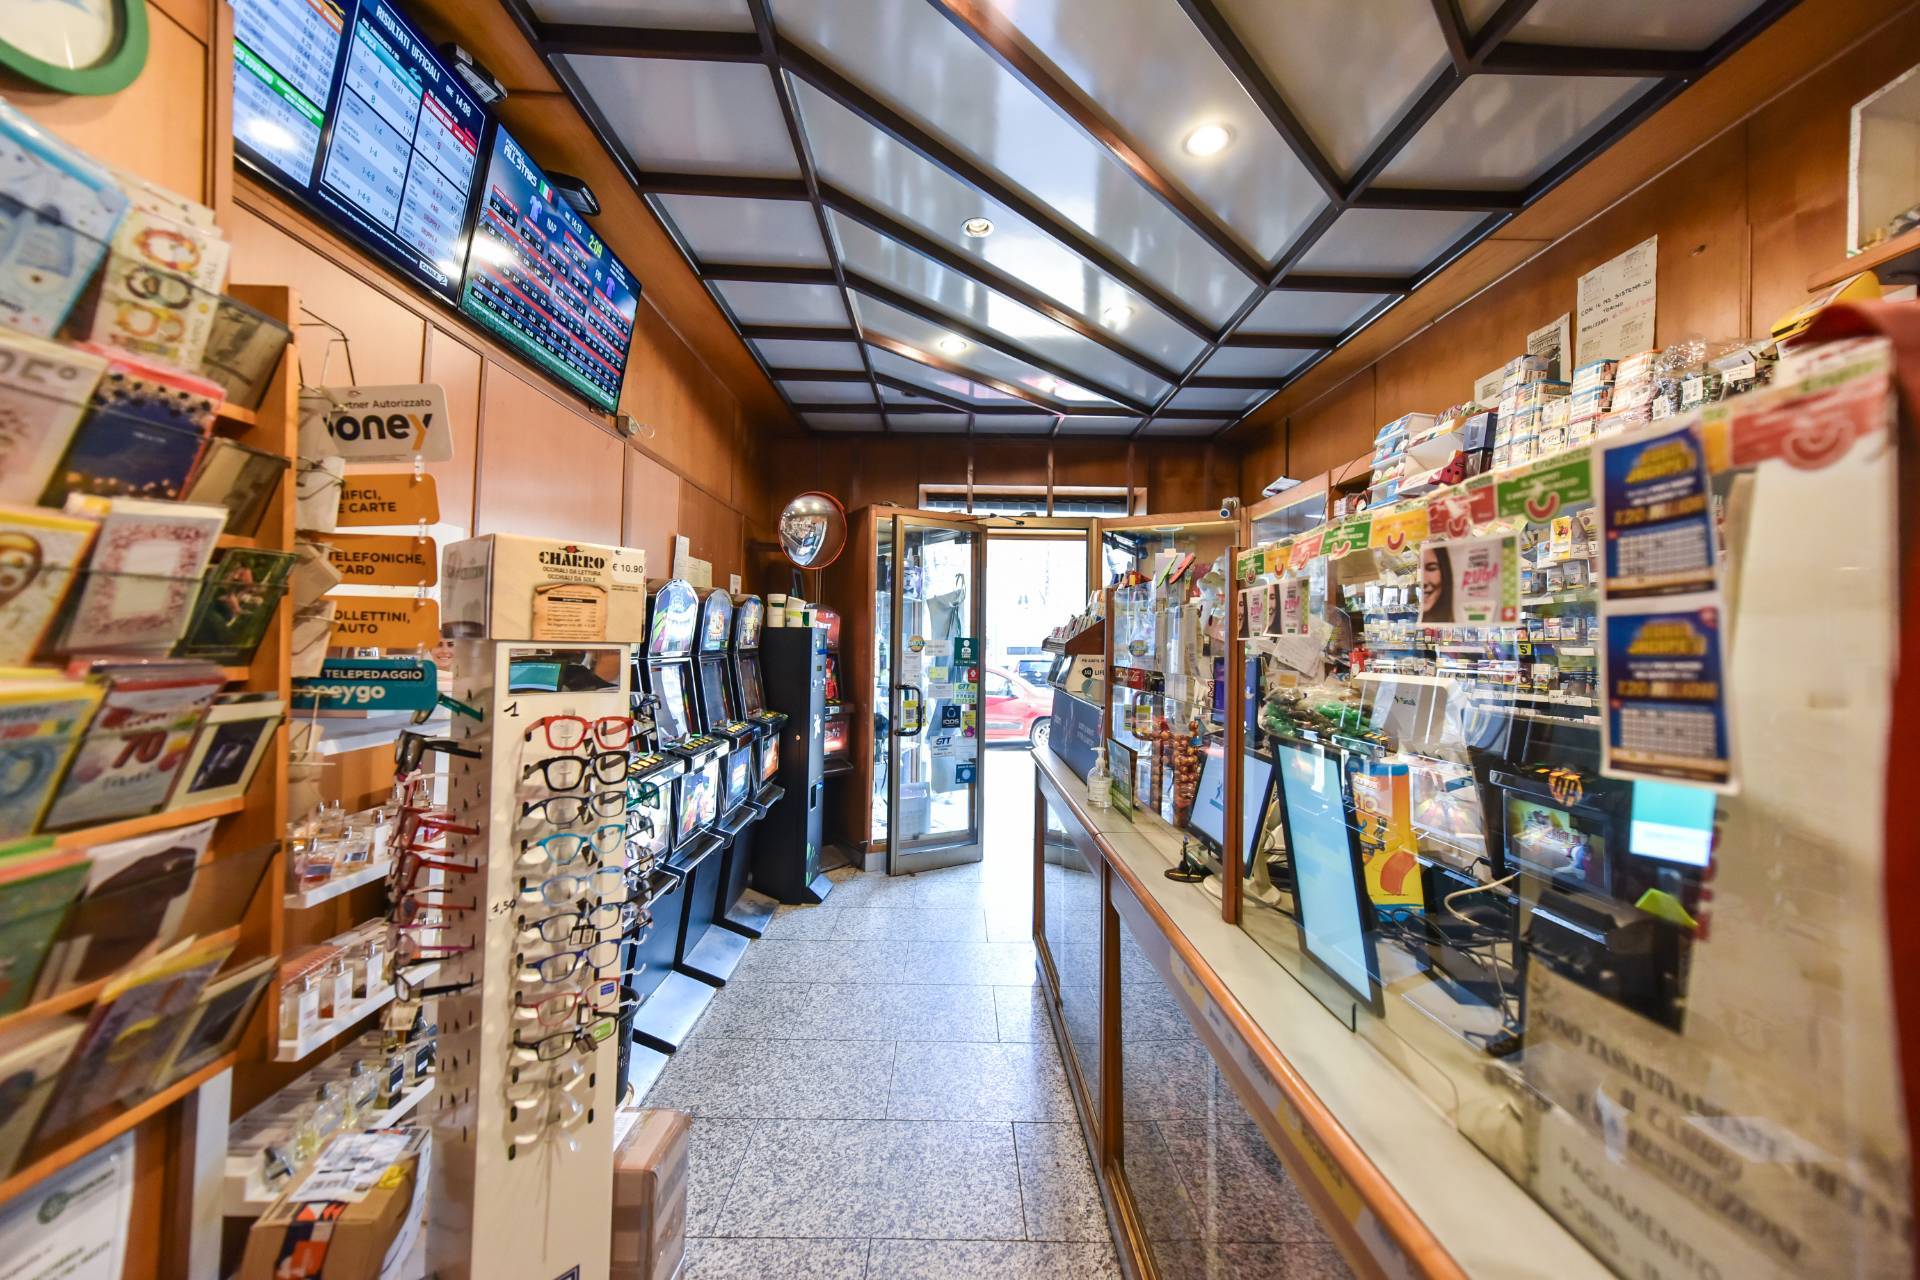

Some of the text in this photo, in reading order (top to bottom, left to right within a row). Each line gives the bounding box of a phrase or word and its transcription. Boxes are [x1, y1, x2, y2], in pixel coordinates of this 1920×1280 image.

[376, 5, 410, 49] RISULTATI
[411, 44, 440, 82] UFFICIALI
[373, 398, 432, 409] Autorizzato
[349, 502, 397, 513] CARTE
[328, 552, 426, 566] TELEFONICHE,
[538, 551, 605, 569] CHARRO
[578, 569, 601, 577] LETTURA
[612, 563, 644, 574] € 10.90
[338, 624, 378, 633] AUTO
[325, 669, 423, 680] TELEPEDAGGIO
[503, 701, 519, 717] 1
